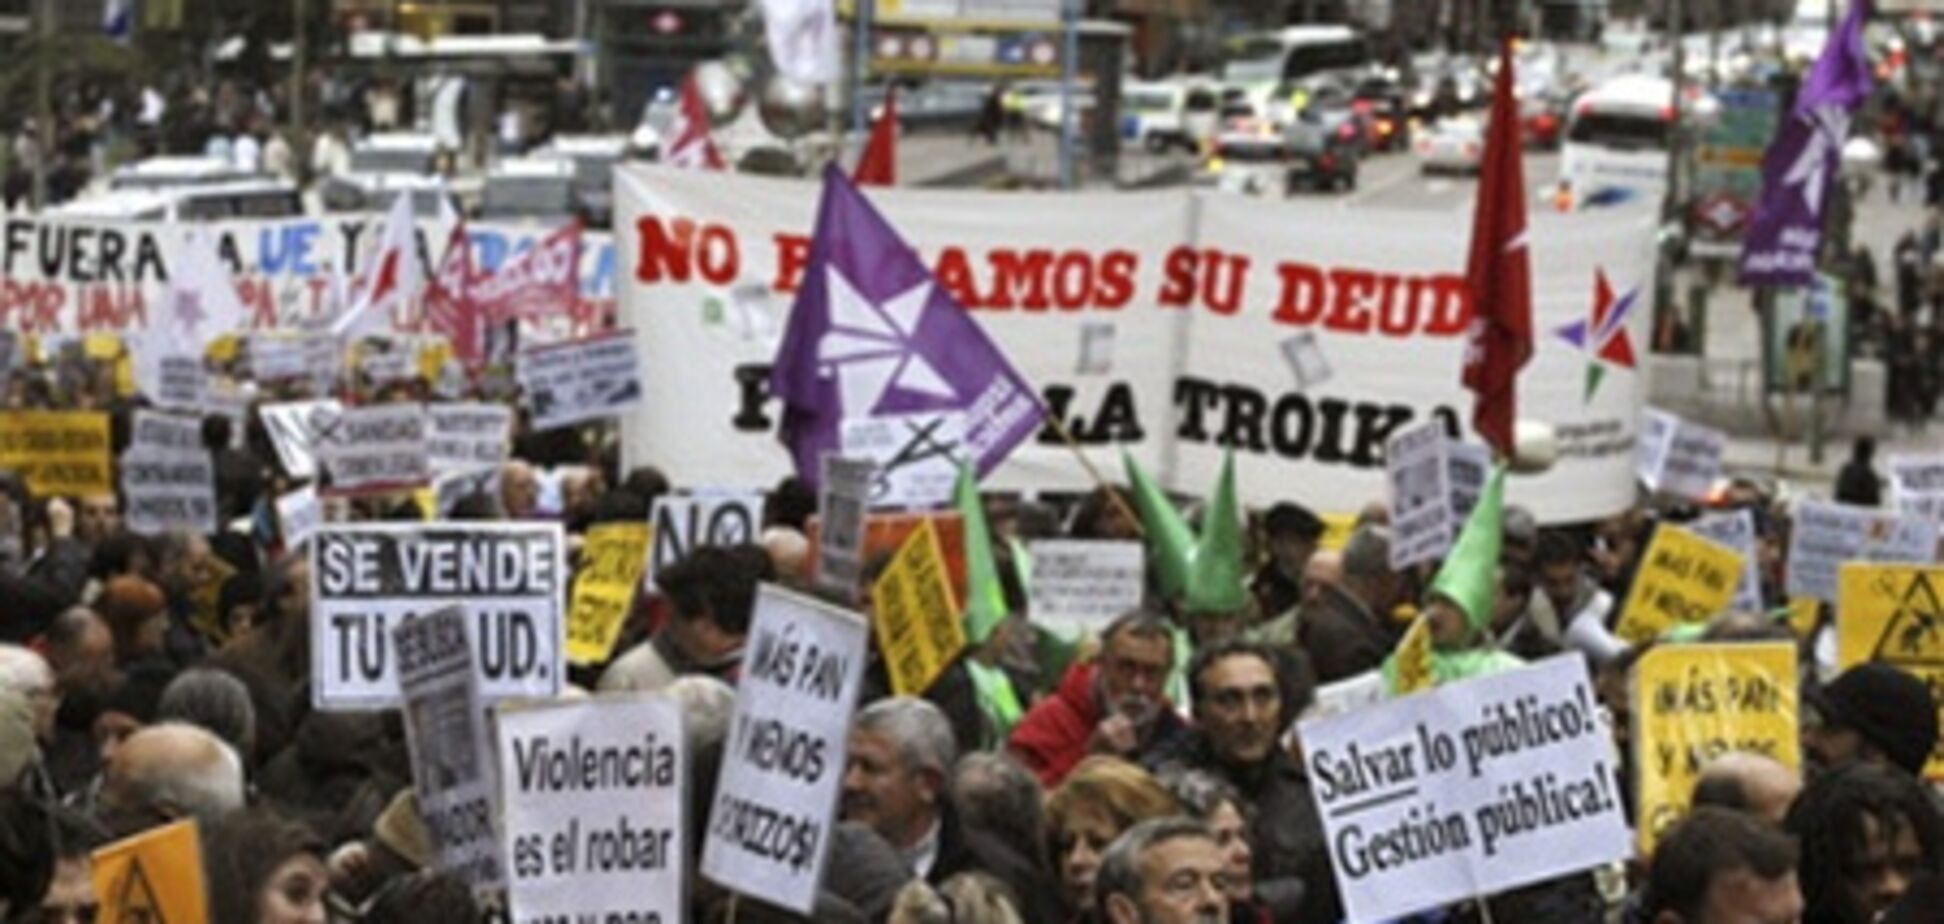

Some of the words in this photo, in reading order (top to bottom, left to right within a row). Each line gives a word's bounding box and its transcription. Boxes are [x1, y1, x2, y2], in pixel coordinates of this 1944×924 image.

[4, 219, 168, 283] FUERA
[339, 220, 363, 274] Y
[636, 217, 740, 285] NO
[772, 232, 1138, 313] PAMOS
[1158, 246, 1250, 315] SU
[1271, 262, 1474, 338] DEUD
[1, 279, 65, 332] POR
[1037, 382, 1145, 446] LA
[322, 540, 380, 592] SE
[401, 540, 550, 592] VENDE
[332, 612, 386, 683] TU
[513, 734, 675, 792] Violencia
[1311, 741, 1419, 803] Salvar
[1416, 722, 1457, 773] lo
[1461, 683, 1597, 778] público!
[513, 838, 544, 878] es
[551, 825, 577, 874] el
[587, 813, 674, 872] robar
[1335, 802, 1471, 879] Gestión
[1476, 760, 1615, 858] pública!
